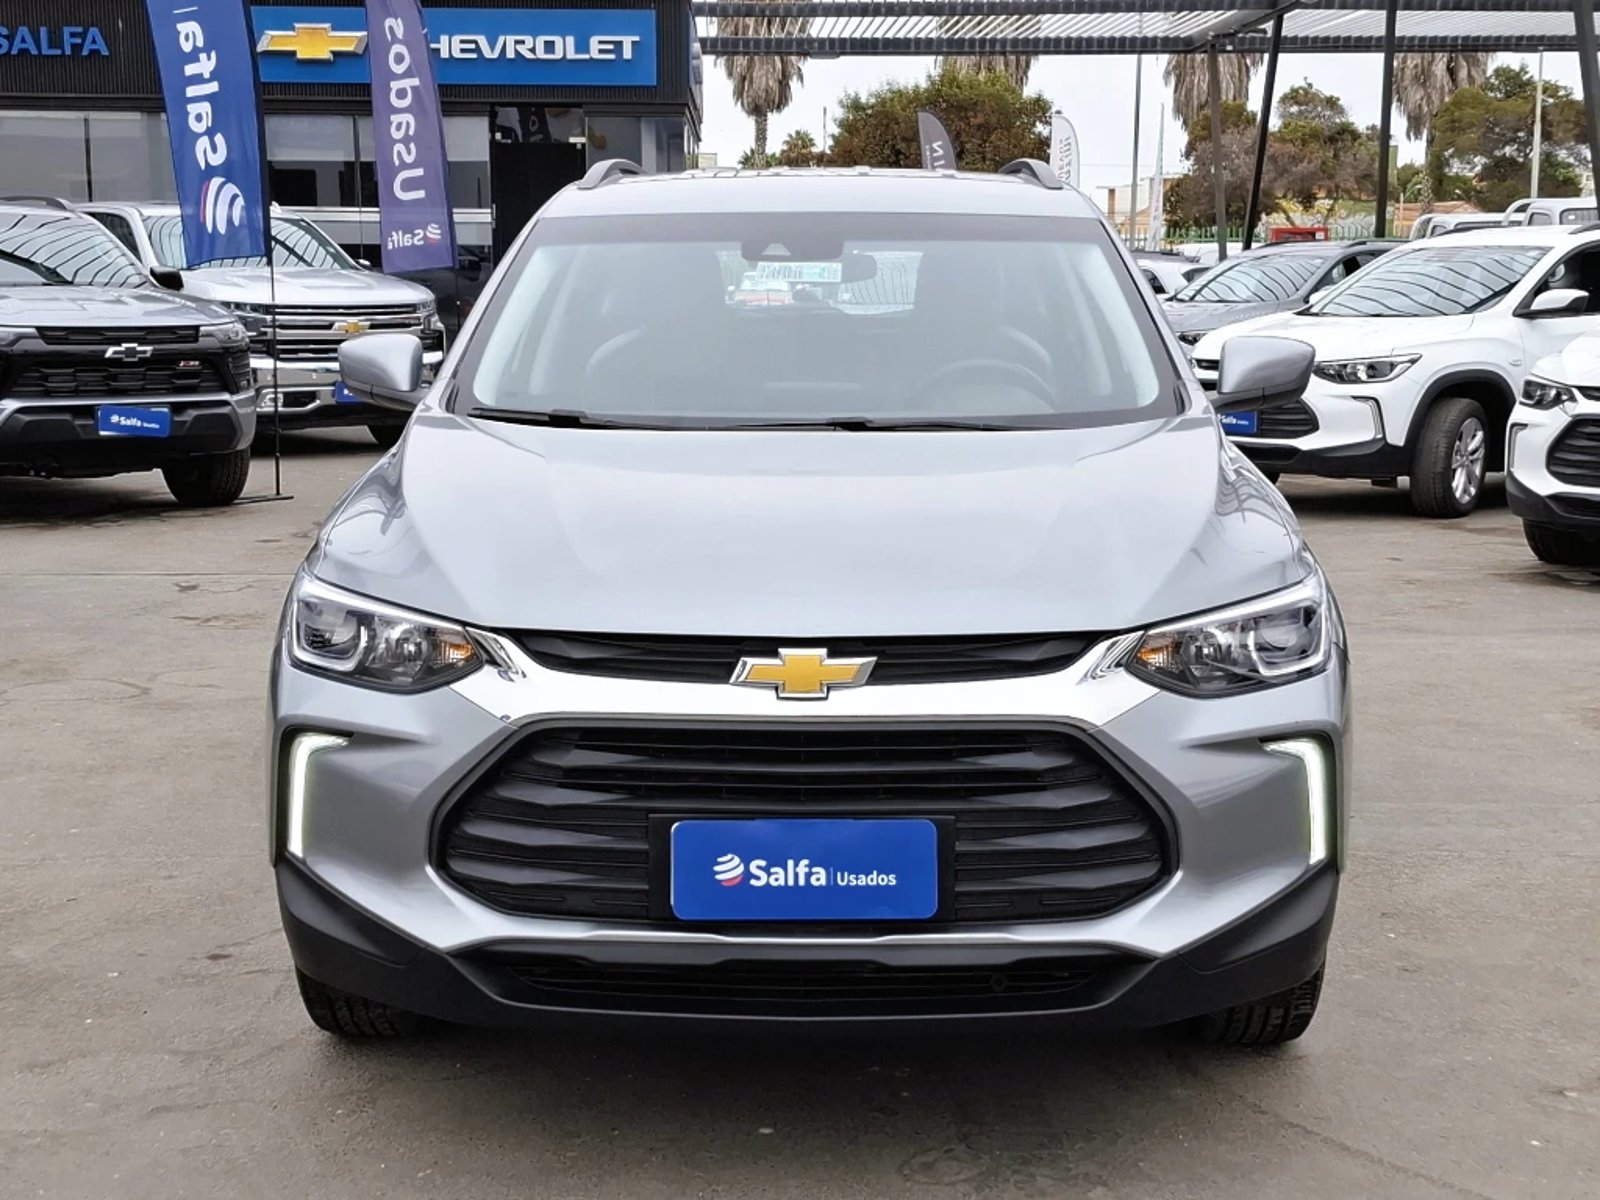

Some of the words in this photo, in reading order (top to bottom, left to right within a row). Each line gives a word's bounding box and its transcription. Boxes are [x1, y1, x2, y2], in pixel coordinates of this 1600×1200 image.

[429, 35, 640, 60] HEVROLET
[749, 858, 828, 887] Salfa
[836, 870, 897, 886] Usados
